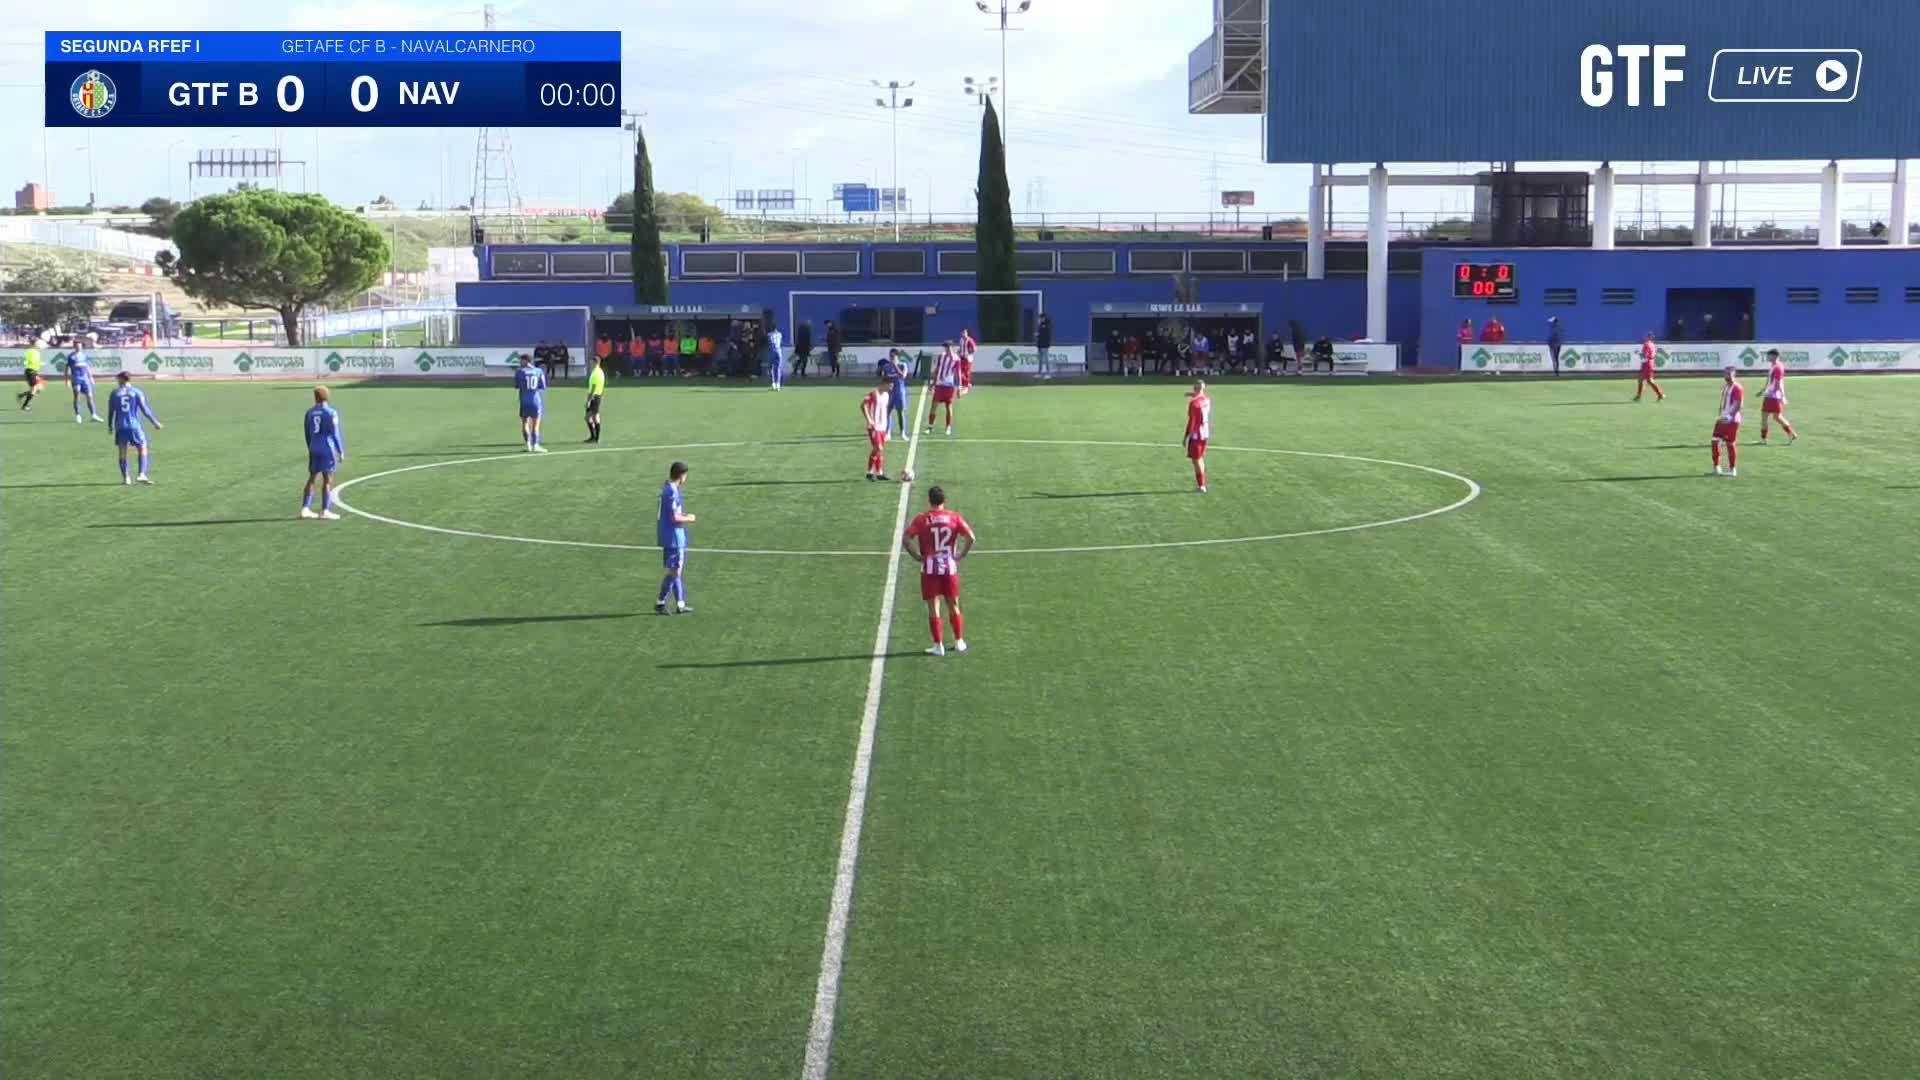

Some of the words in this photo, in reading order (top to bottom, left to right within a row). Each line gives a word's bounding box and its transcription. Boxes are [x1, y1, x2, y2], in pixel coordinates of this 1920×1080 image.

[1460, 265, 1470, 279] 0
[1499, 265, 1509, 279] 0
[1473, 281, 1495, 295] 00
[525, 375, 538, 390] 10
[121, 396, 130, 412] 5
[930, 526, 952, 552] 12
